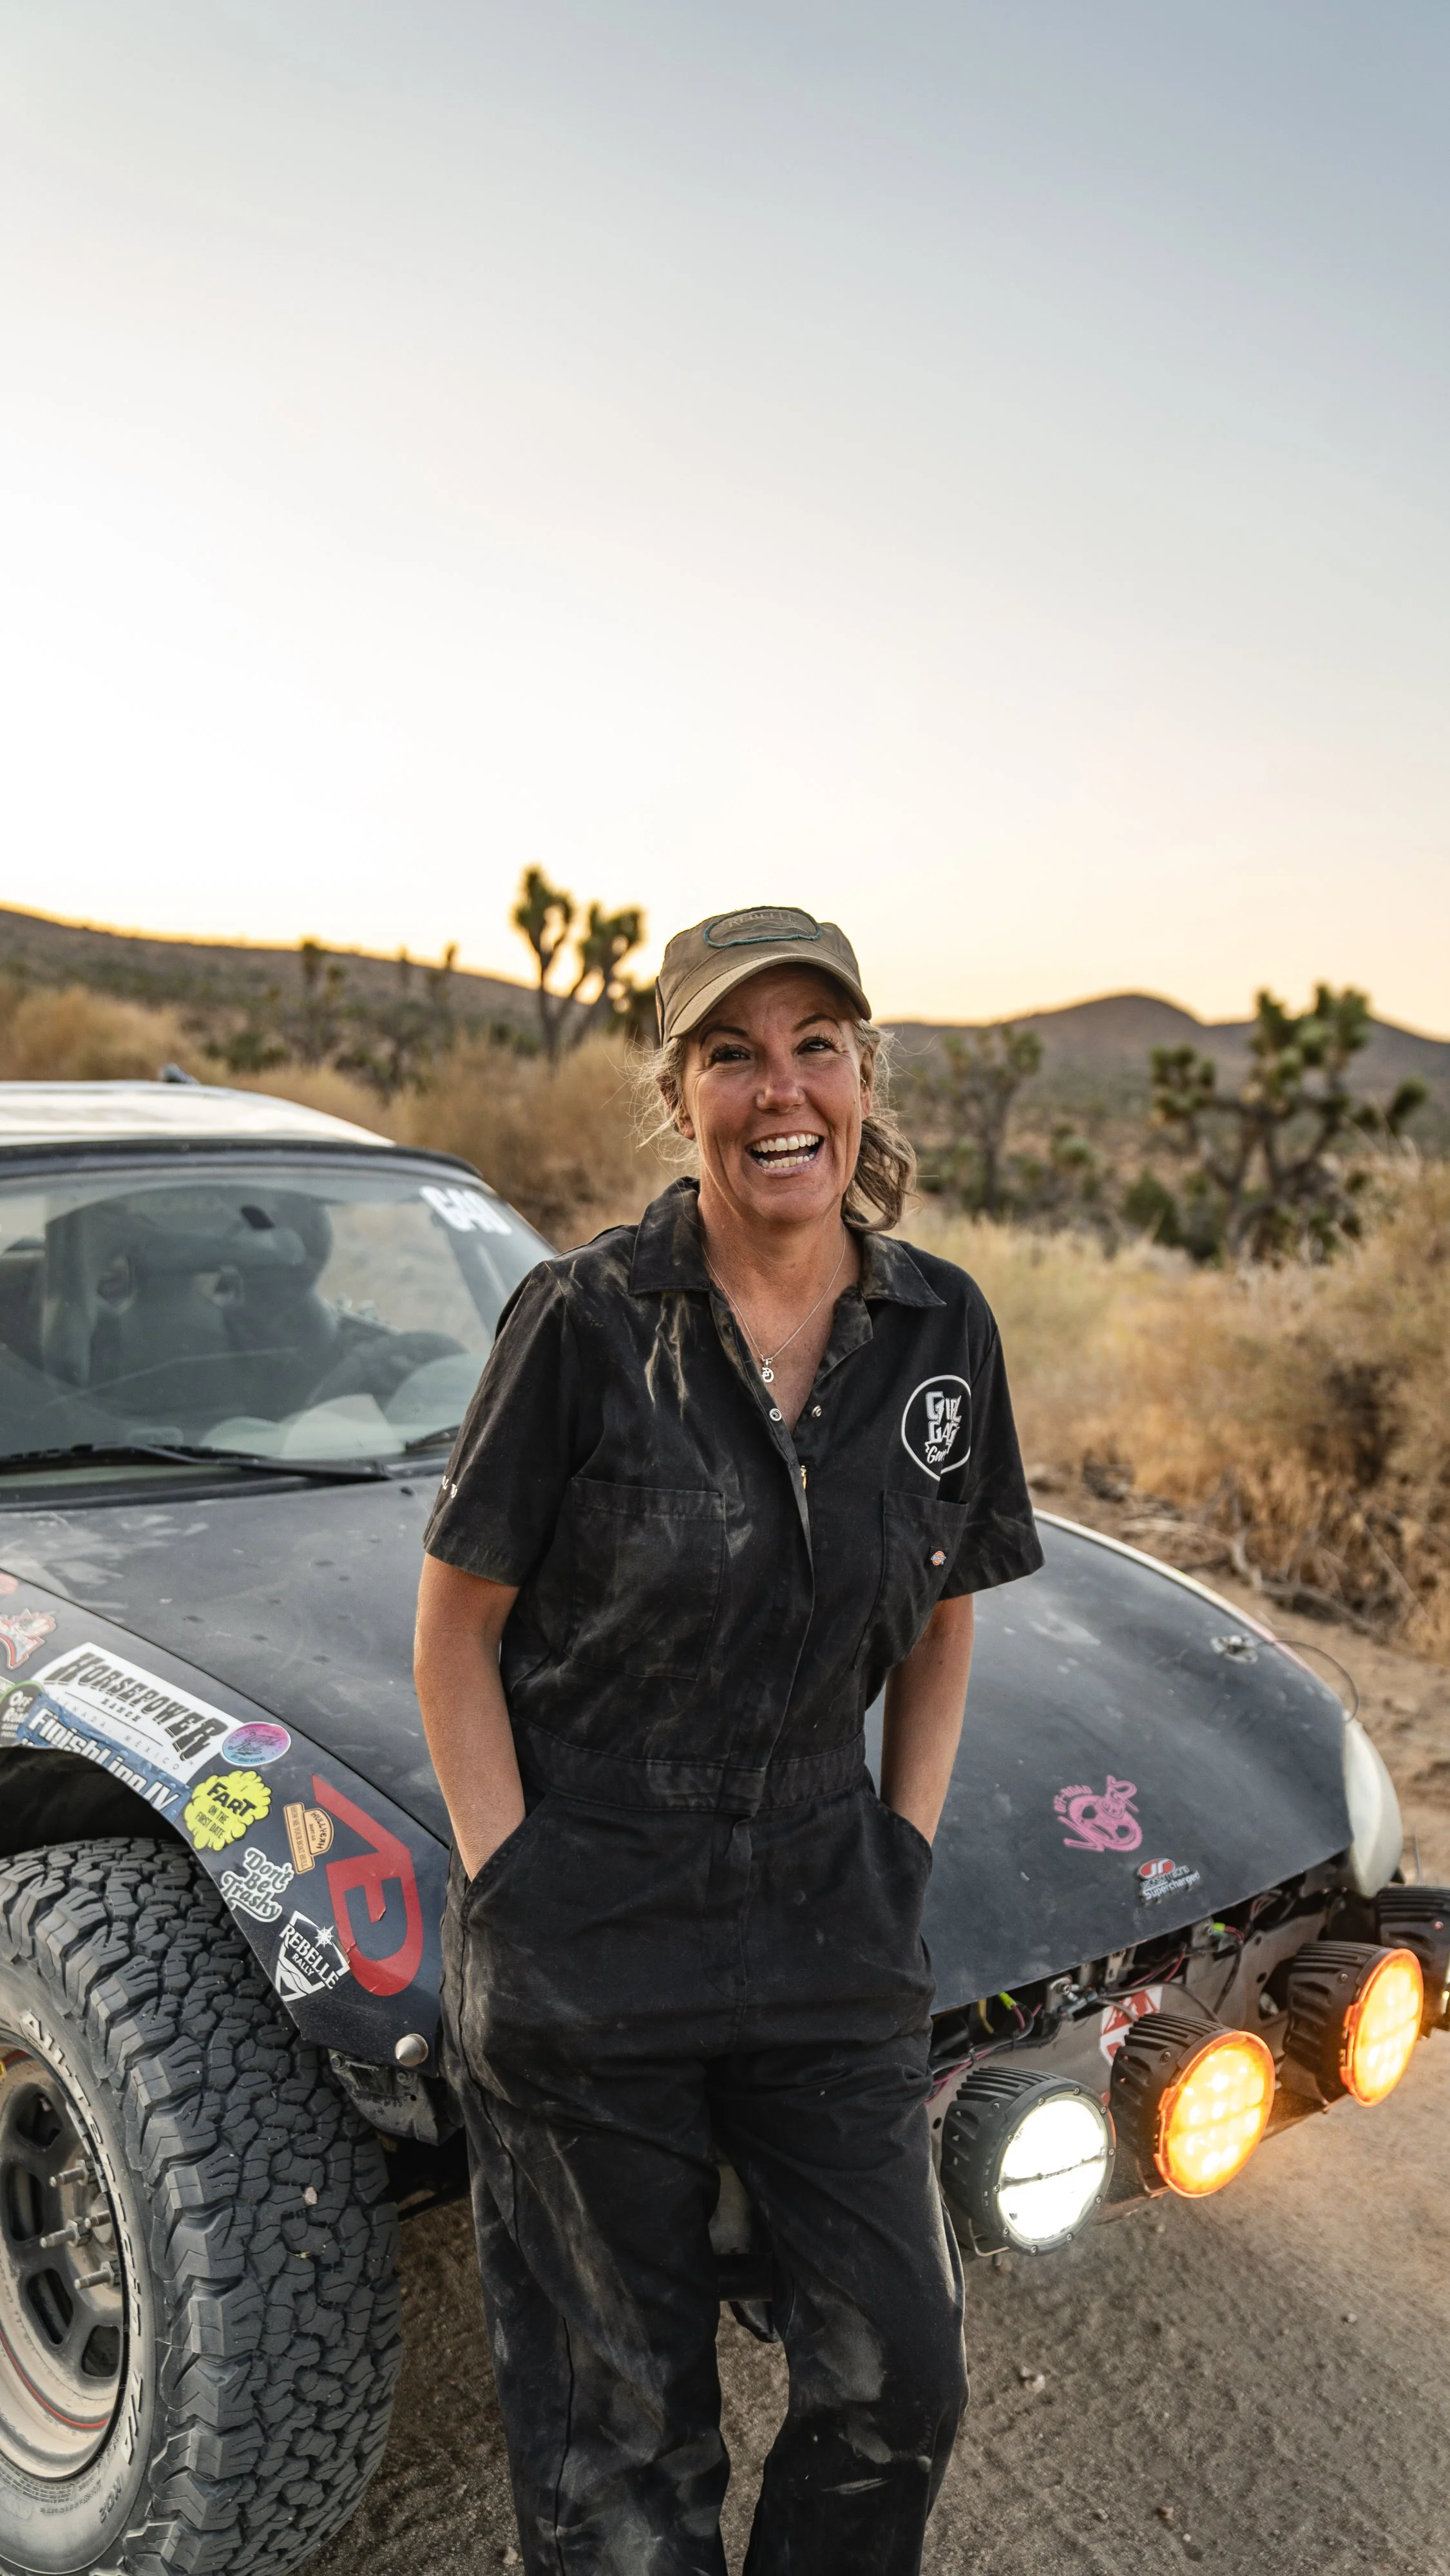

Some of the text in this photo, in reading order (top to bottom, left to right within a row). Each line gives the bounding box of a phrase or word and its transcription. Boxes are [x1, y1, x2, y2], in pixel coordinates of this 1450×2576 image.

[925, 1390, 962, 1426] GIRL
[44, 1651, 229, 1761] HORSEPOWER
[206, 1781, 258, 1817] FART
[208, 1804, 229, 1824] ON THE
[195, 1811, 225, 1839] FIRST DATE
[244, 1871, 271, 1893] Be
[247, 1851, 292, 1890] Don't
[1143, 1870, 1201, 1900] Supercharged
[223, 1875, 281, 1920] Trashy
[279, 1924, 339, 1989] REBELLE
[292, 1953, 315, 1976] RALLY
